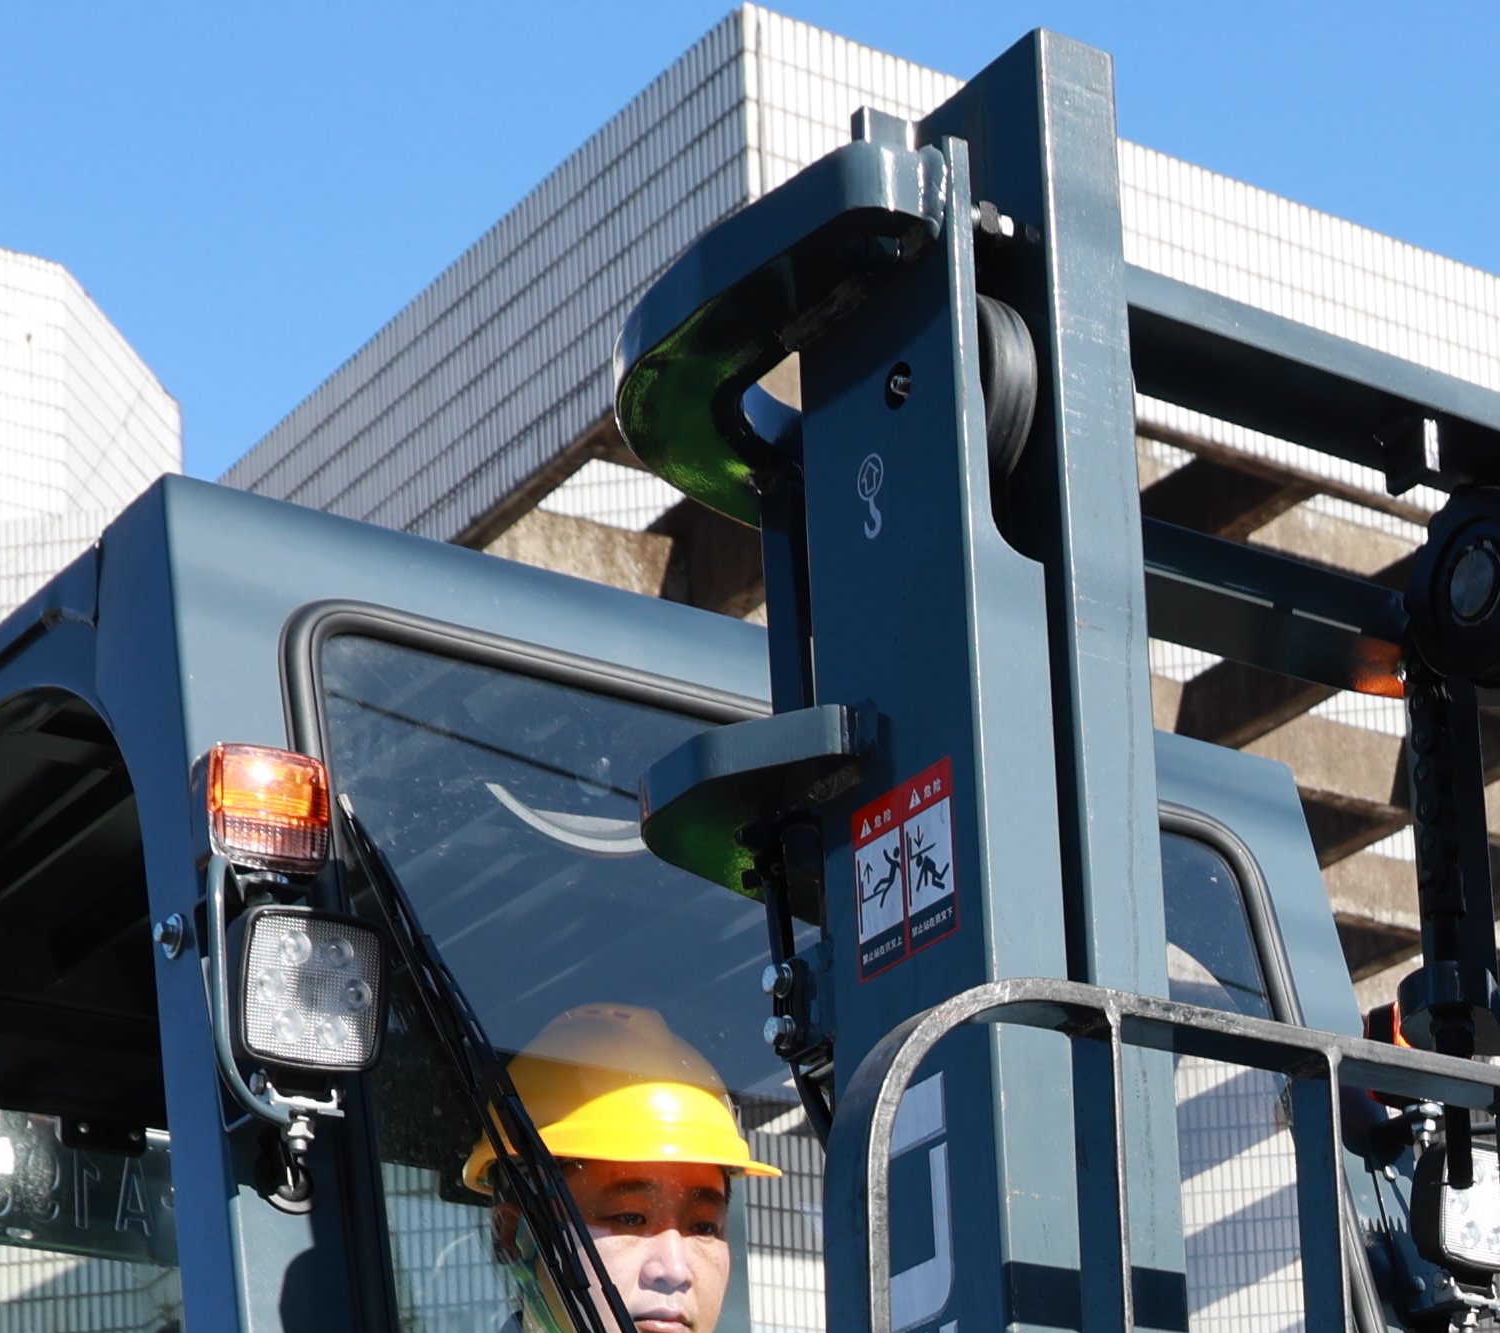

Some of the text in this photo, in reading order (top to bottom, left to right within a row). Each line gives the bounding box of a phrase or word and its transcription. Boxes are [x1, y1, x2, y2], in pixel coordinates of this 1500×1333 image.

[923, 778, 943, 800] 危险
[873, 808, 893, 830] 危险
[911, 905, 954, 938] 禁止站在货叉下
[862, 935, 904, 966] 禁止站在货叉上
